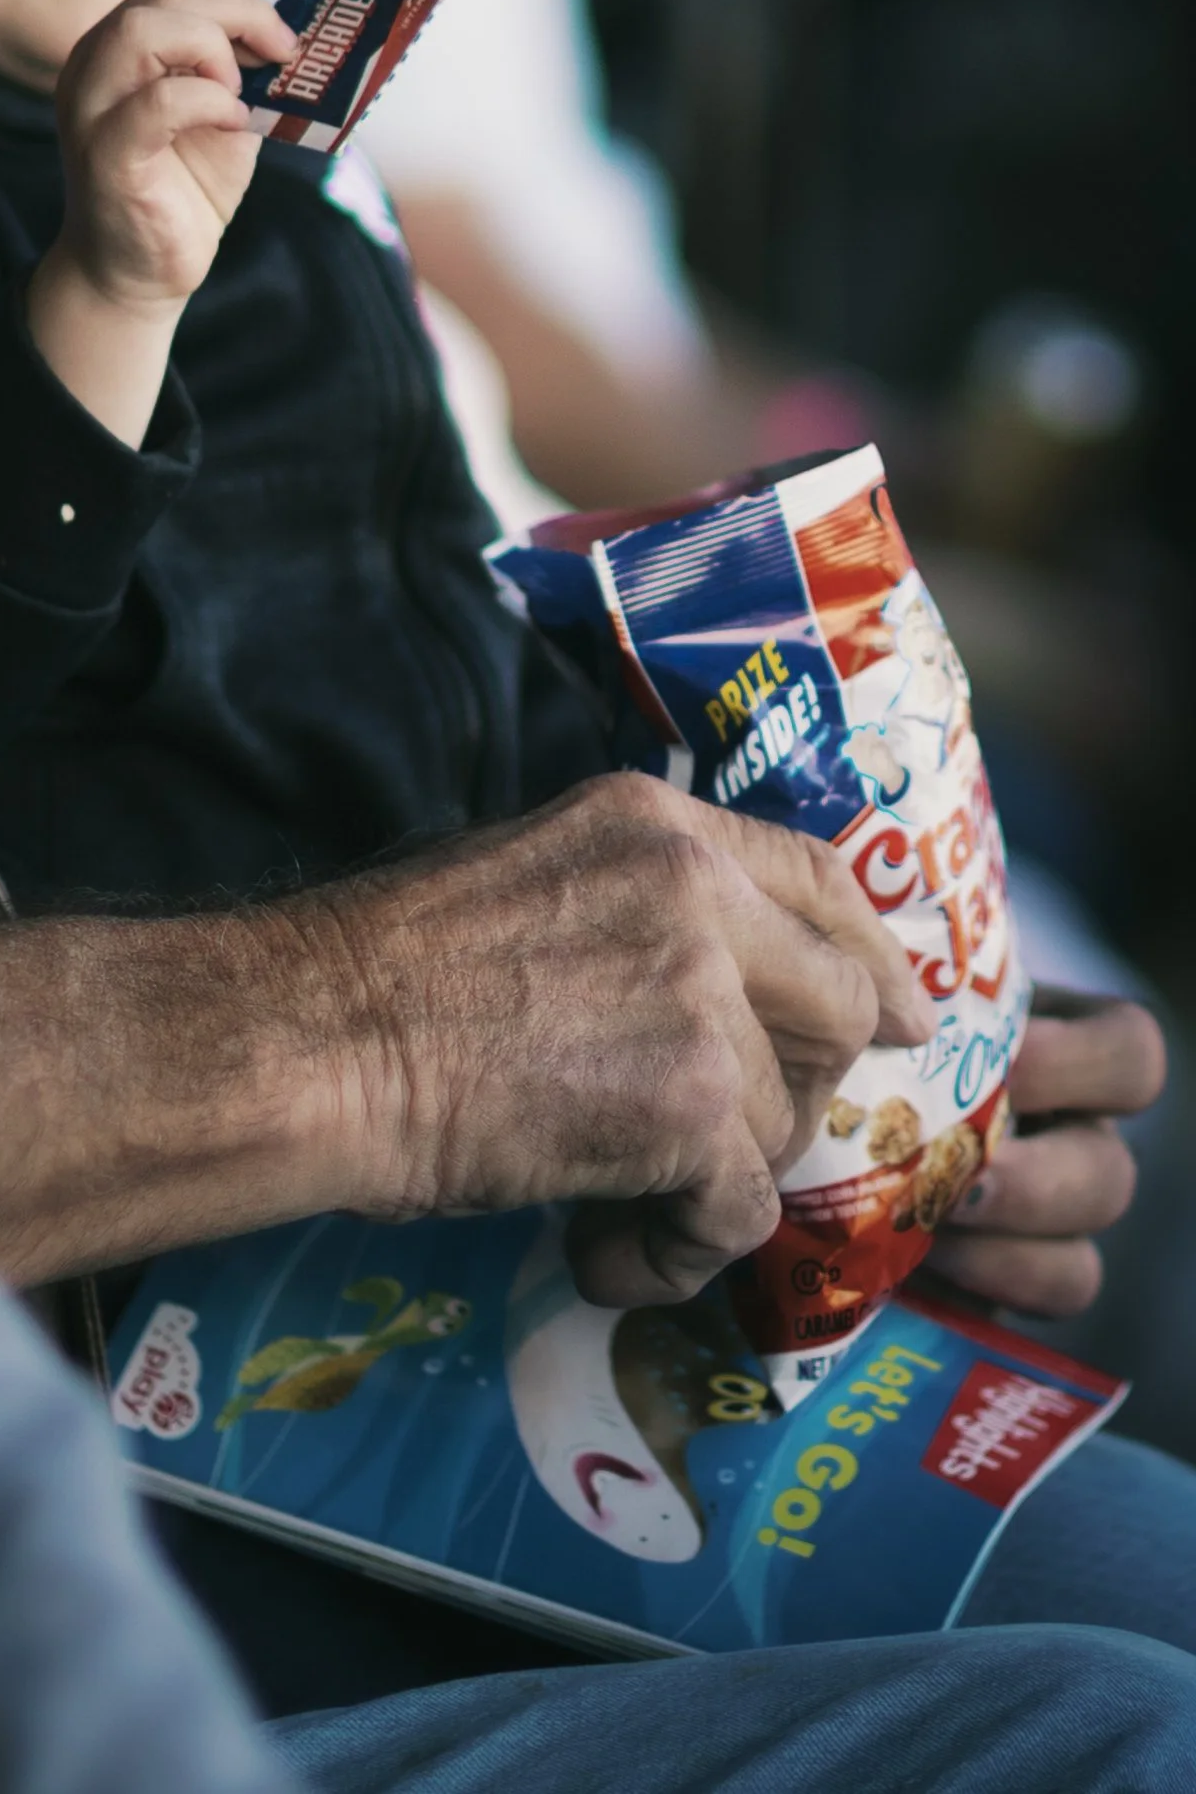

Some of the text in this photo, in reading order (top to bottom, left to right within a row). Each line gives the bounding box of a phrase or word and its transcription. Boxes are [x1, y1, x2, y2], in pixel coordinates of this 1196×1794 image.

[705, 636, 790, 743] PRIZE
[714, 671, 822, 805] INSIDE!
[120, 1345, 171, 1417] play
[826, 1344, 943, 1437] Let's
[757, 1442, 859, 1559] Go!
